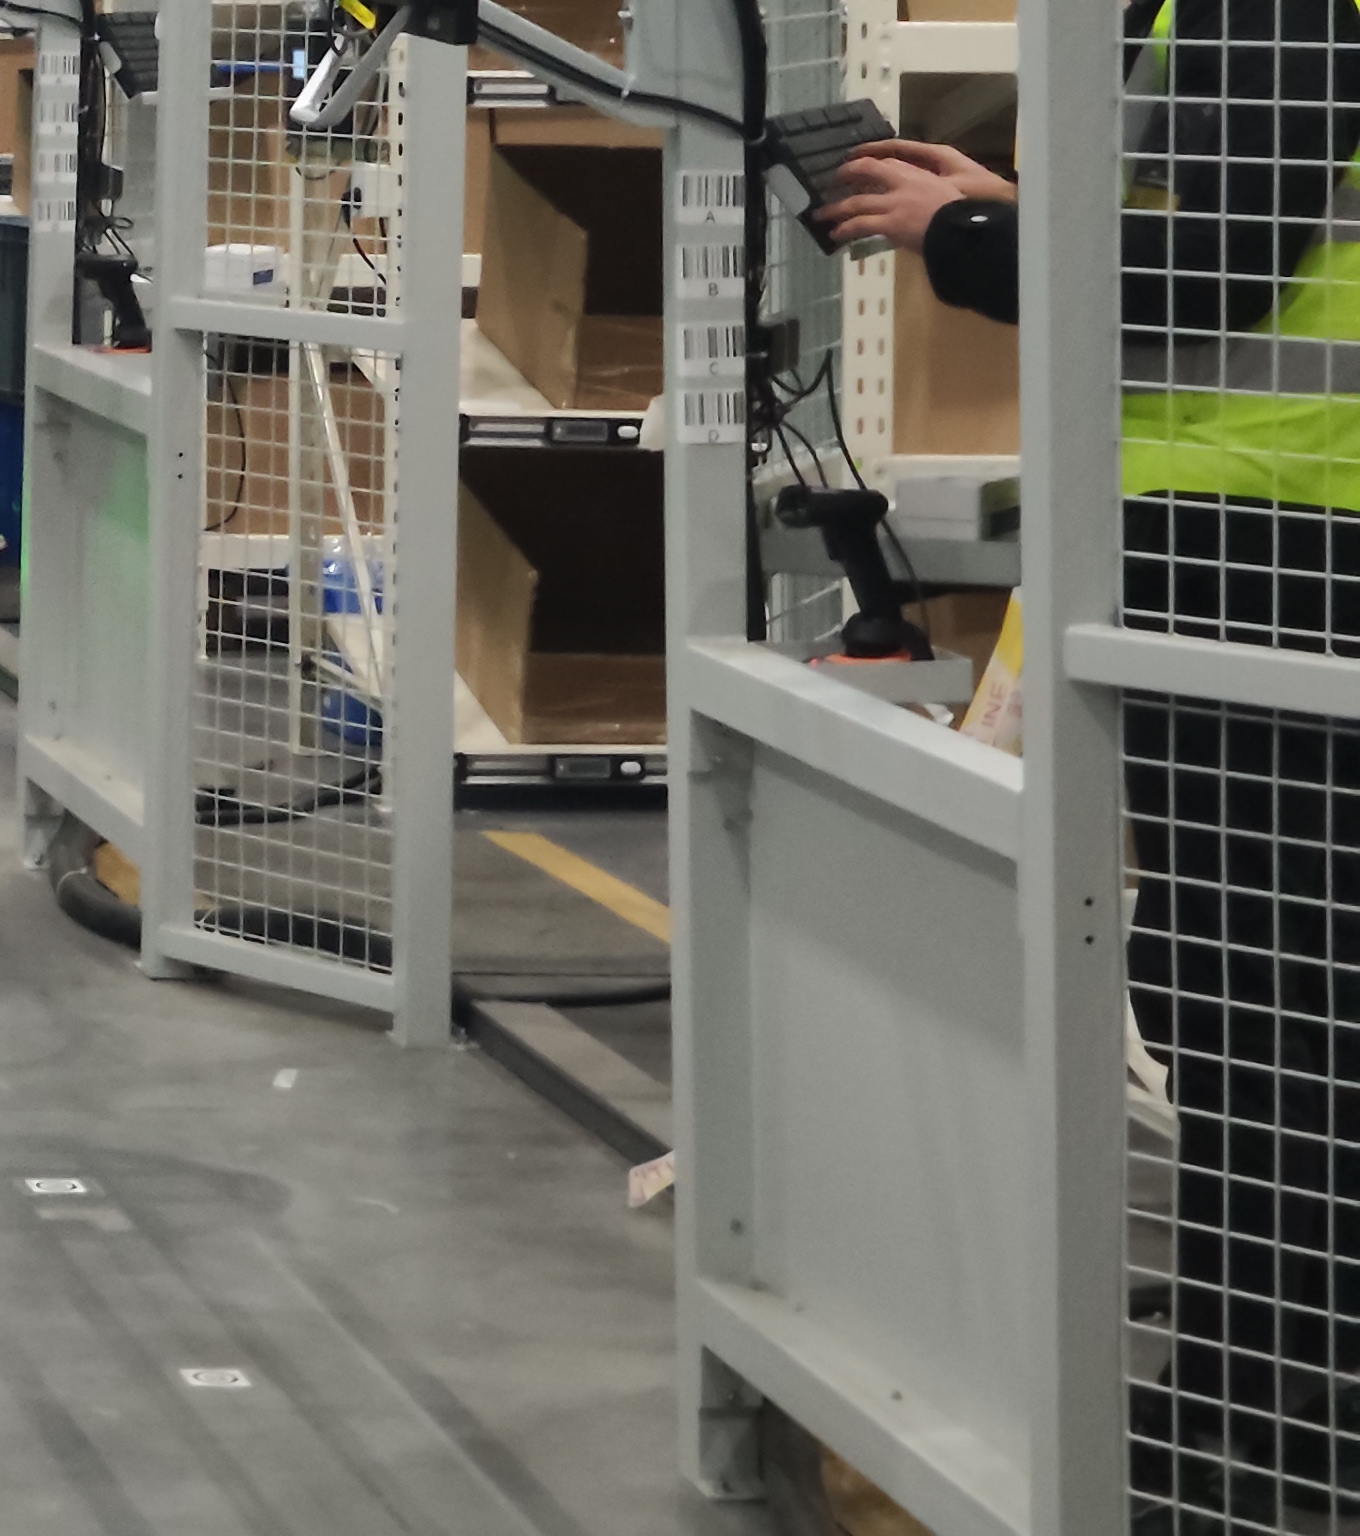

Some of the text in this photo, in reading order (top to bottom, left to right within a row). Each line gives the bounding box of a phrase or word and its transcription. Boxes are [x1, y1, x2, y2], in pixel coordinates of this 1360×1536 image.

[705, 210, 716, 223] A
[708, 282, 719, 296] B
[709, 361, 719, 375] C
[708, 429, 720, 443] D
